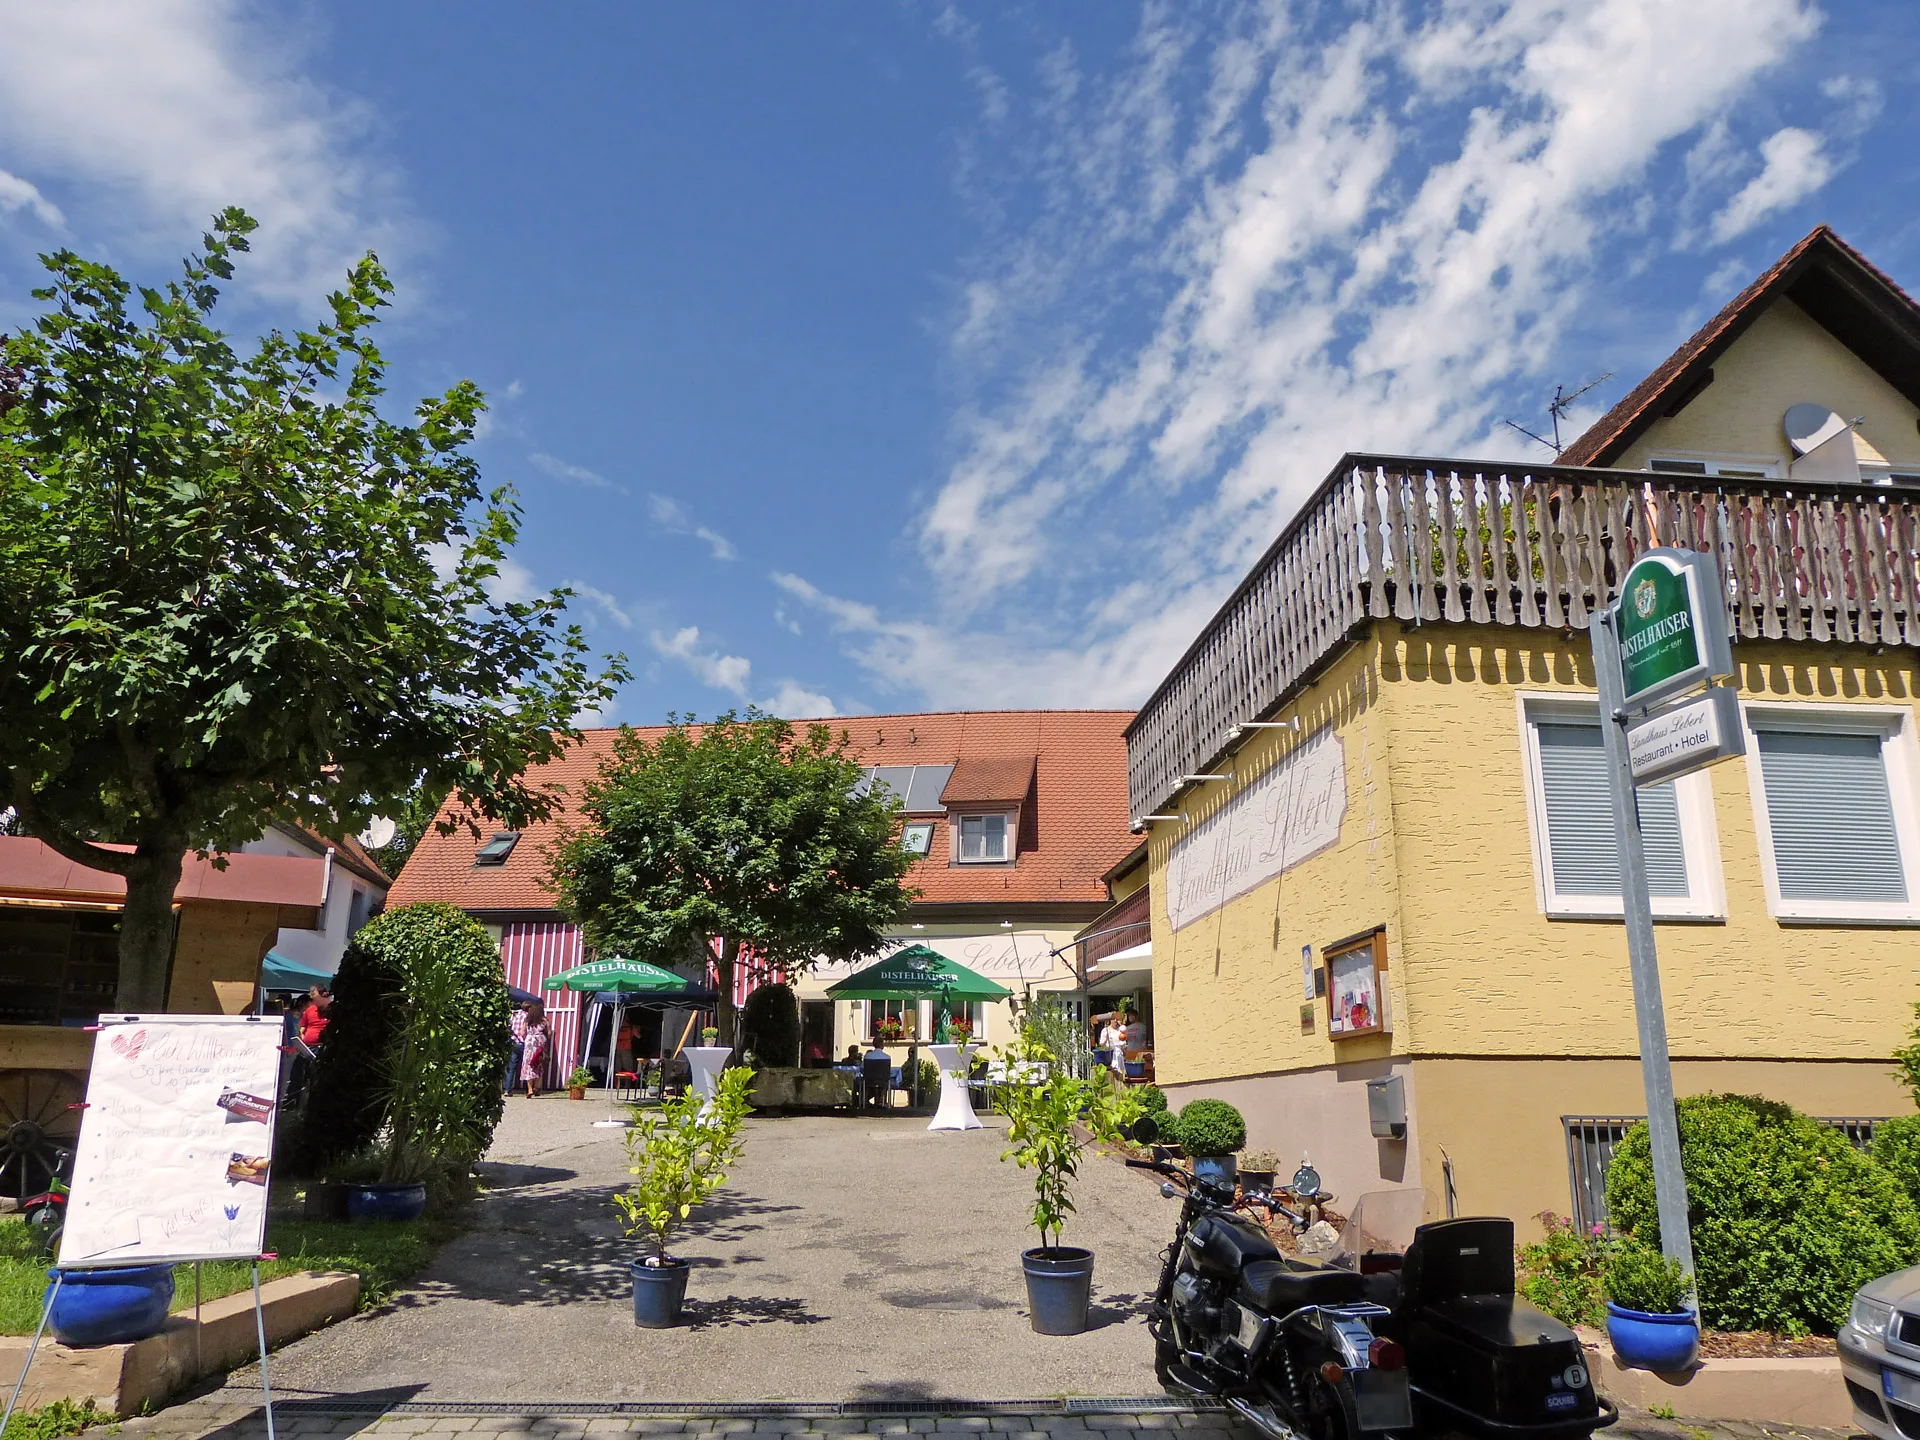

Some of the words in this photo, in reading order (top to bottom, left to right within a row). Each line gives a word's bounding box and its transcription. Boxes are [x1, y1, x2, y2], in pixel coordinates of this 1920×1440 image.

[1621, 610, 1690, 661] DISTELHÄUSER
[1631, 725, 1668, 751] Landhaus
[1671, 712, 1705, 733] Lebert
[1632, 743, 1674, 768] Restaurant
[1681, 730, 1710, 750] Hotel
[963, 943, 1043, 972] Lebert
[1547, 1396, 1576, 1407] SQUIRE
